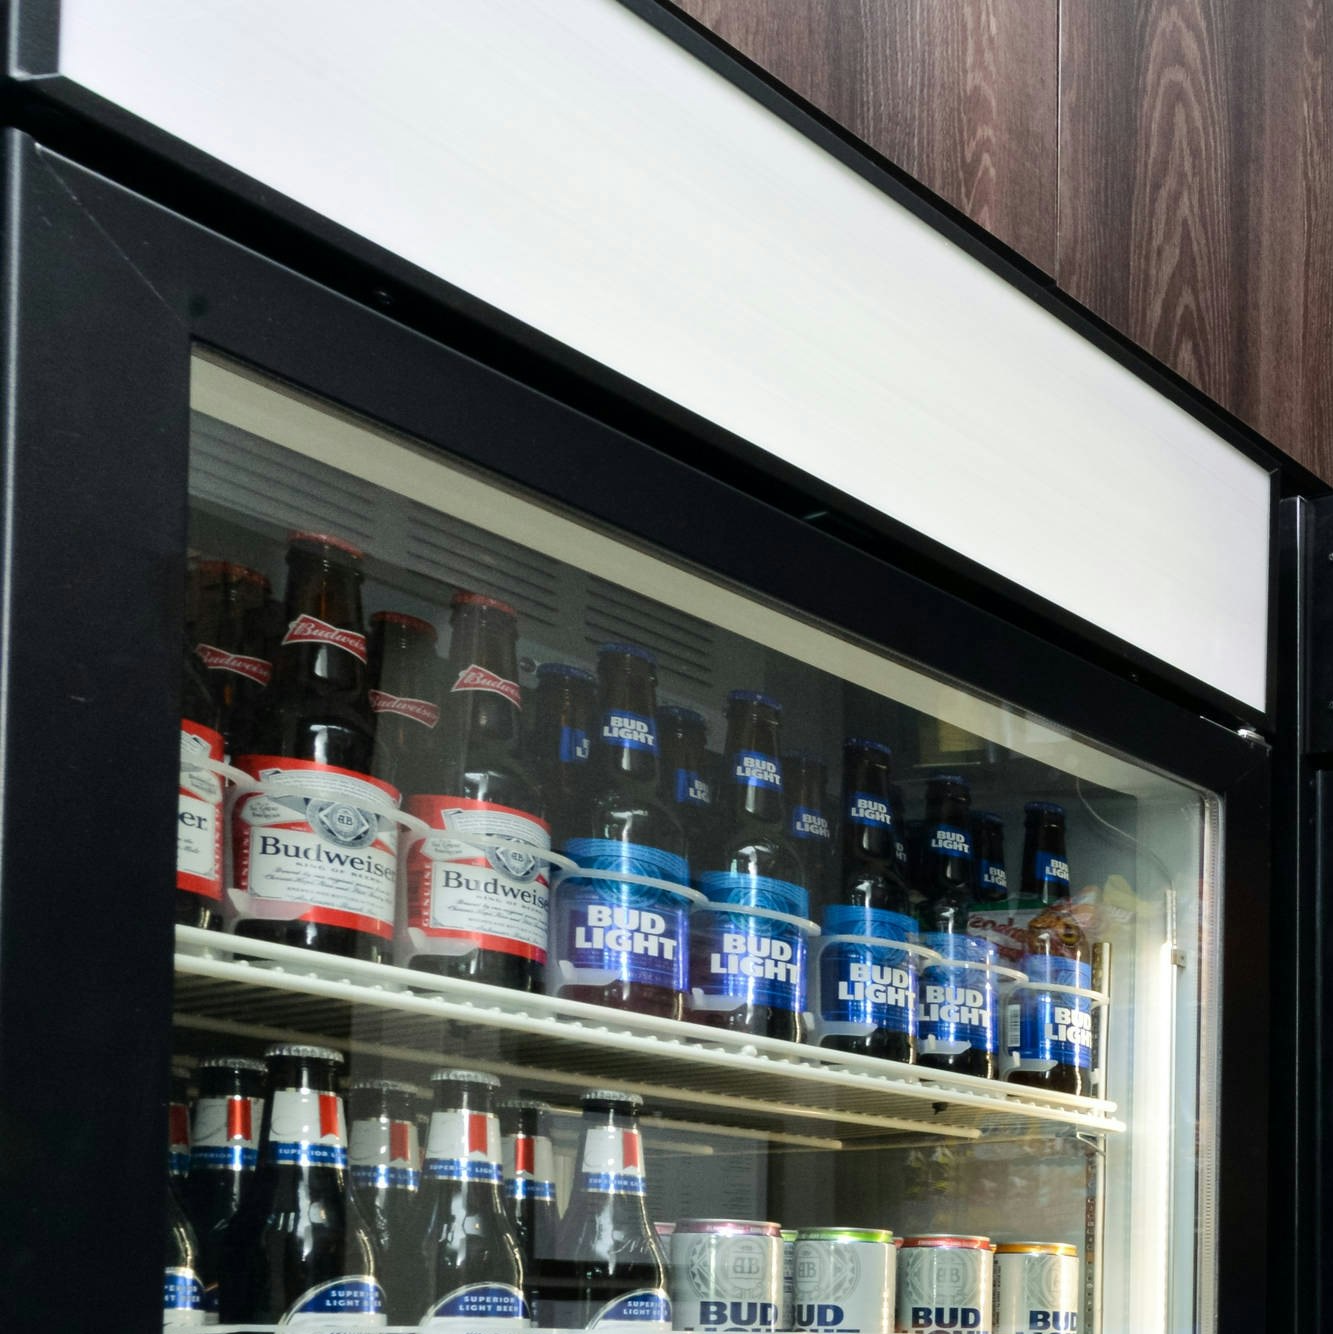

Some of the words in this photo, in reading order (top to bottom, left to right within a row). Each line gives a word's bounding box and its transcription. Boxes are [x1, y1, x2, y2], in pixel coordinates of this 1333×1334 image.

[608, 716, 648, 731] BUD
[603, 727, 655, 746] LIGHT
[736, 764, 781, 786] LIGHT
[743, 757, 777, 773] BUD
[851, 807, 892, 826] LIGHT
[857, 799, 888, 818] BUD
[931, 838, 970, 854] LIGHT
[936, 830, 966, 844] BUD
[587, 906, 667, 935] BUD
[575, 927, 677, 961] LIGHT
[722, 933, 793, 962] BUD
[711, 953, 799, 986] LIGHT
[850, 962, 910, 988] BUD
[838, 980, 914, 1010] LIGHT
[925, 985, 984, 1009] BUD
[918, 1003, 991, 1028] LIGHT
[326, 1299, 360, 1308] LIGHT
[459, 1304, 493, 1312] LIGHT
[700, 1301, 778, 1328] BUD
[911, 1307, 981, 1330] BUD
